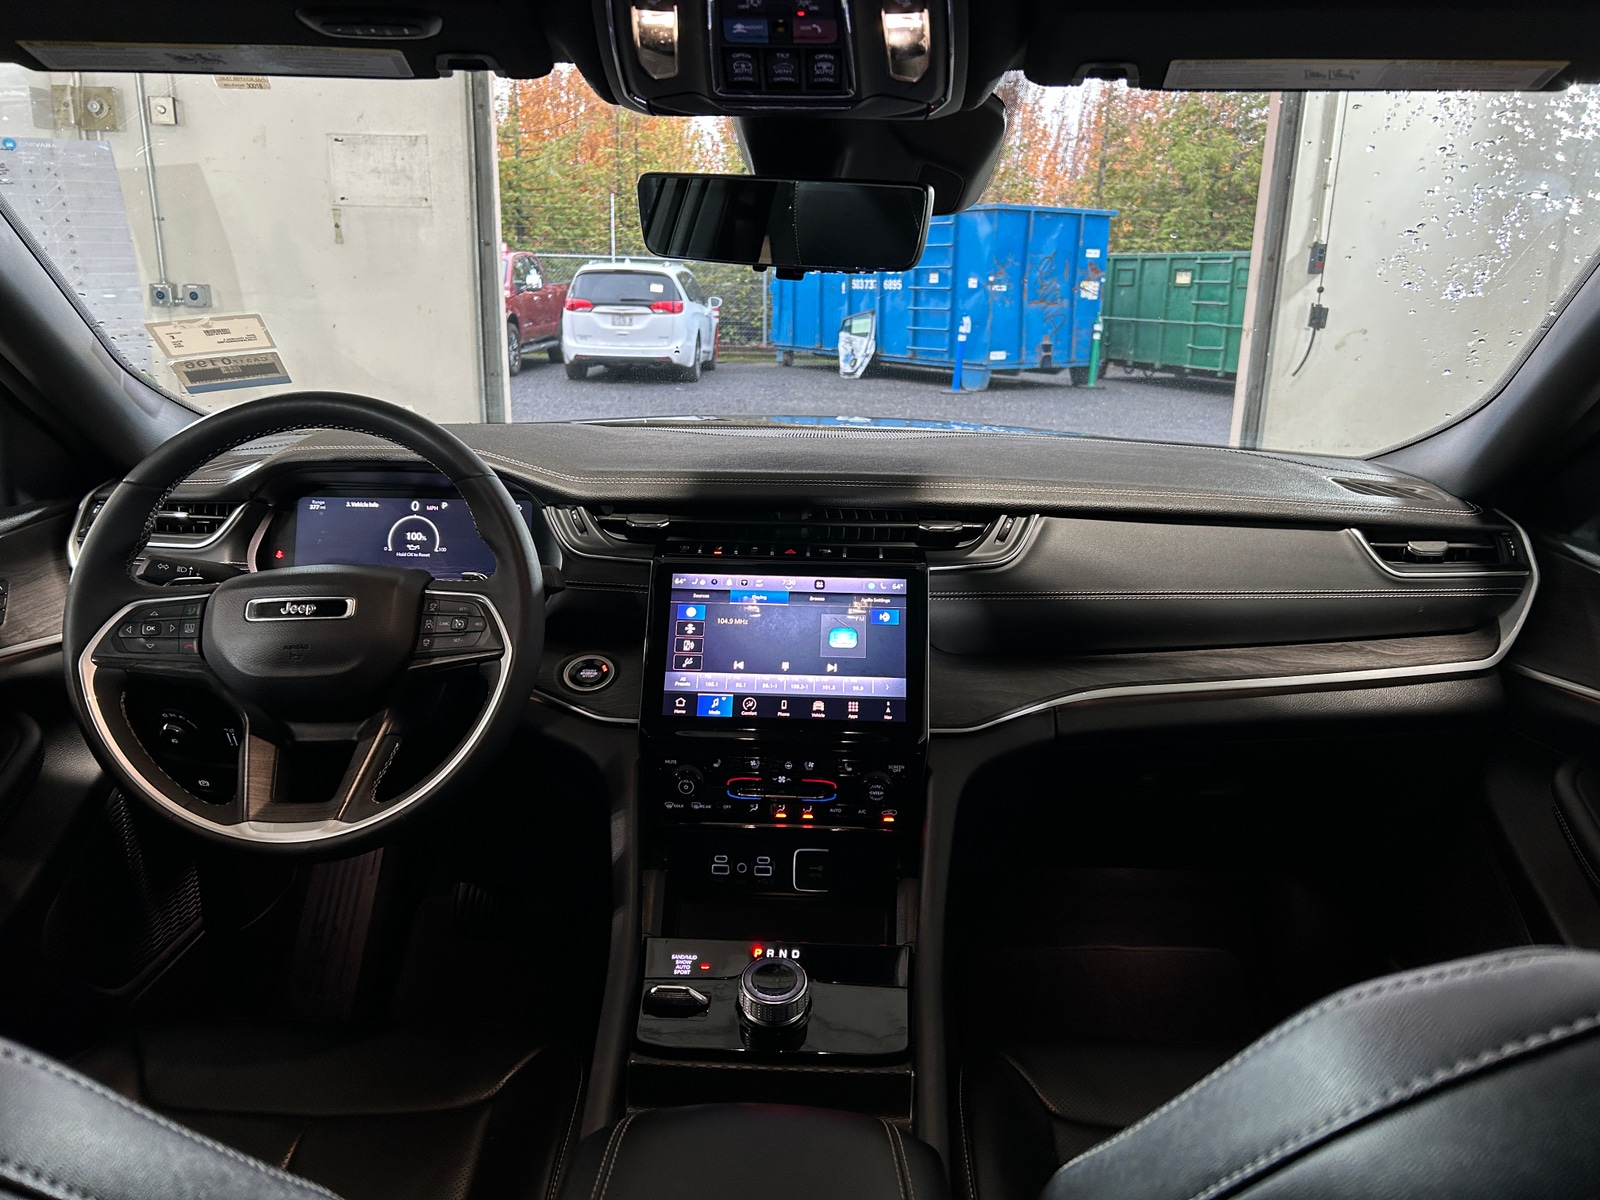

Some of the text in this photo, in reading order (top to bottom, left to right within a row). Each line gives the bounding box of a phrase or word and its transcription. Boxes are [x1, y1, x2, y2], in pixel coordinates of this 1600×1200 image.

[411, 500, 420, 511] 0
[441, 501, 448, 509] P
[406, 531, 427, 541] 100%
[280, 601, 316, 615] Jeep
[754, 948, 800, 959] P R N D
